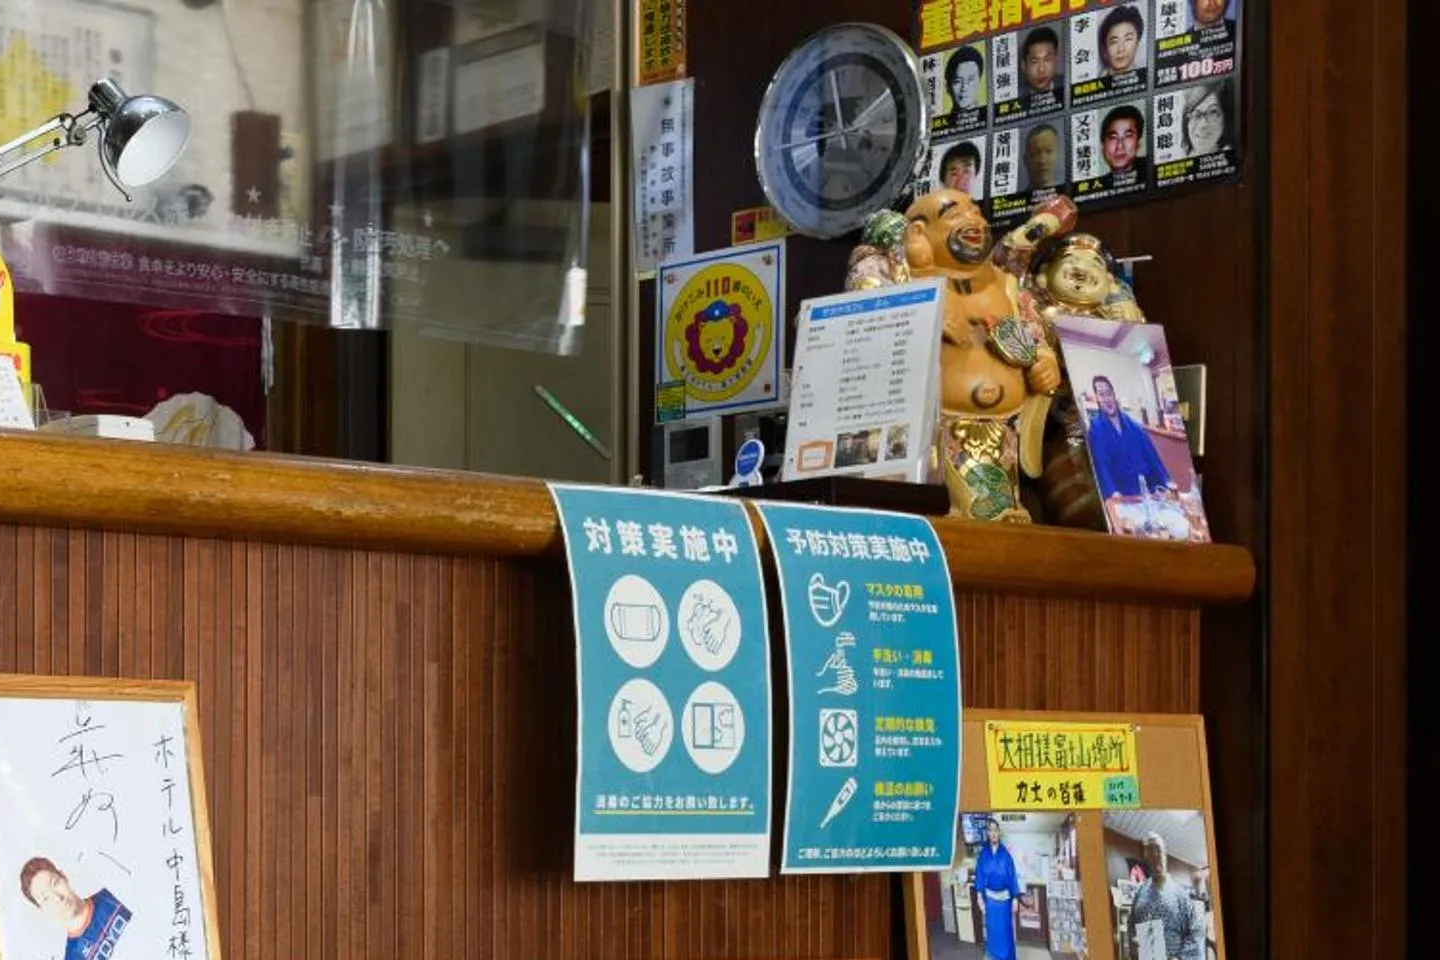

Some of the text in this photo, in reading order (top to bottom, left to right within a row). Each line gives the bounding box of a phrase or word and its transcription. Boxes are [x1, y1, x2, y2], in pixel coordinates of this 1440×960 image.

[583, 517, 739, 564] 対策実施中
[786, 528, 931, 564] 予防対策実施中
[999, 732, 1125, 770] 大相撲富士山場所
[154, 734, 193, 960] ホテル中島様
